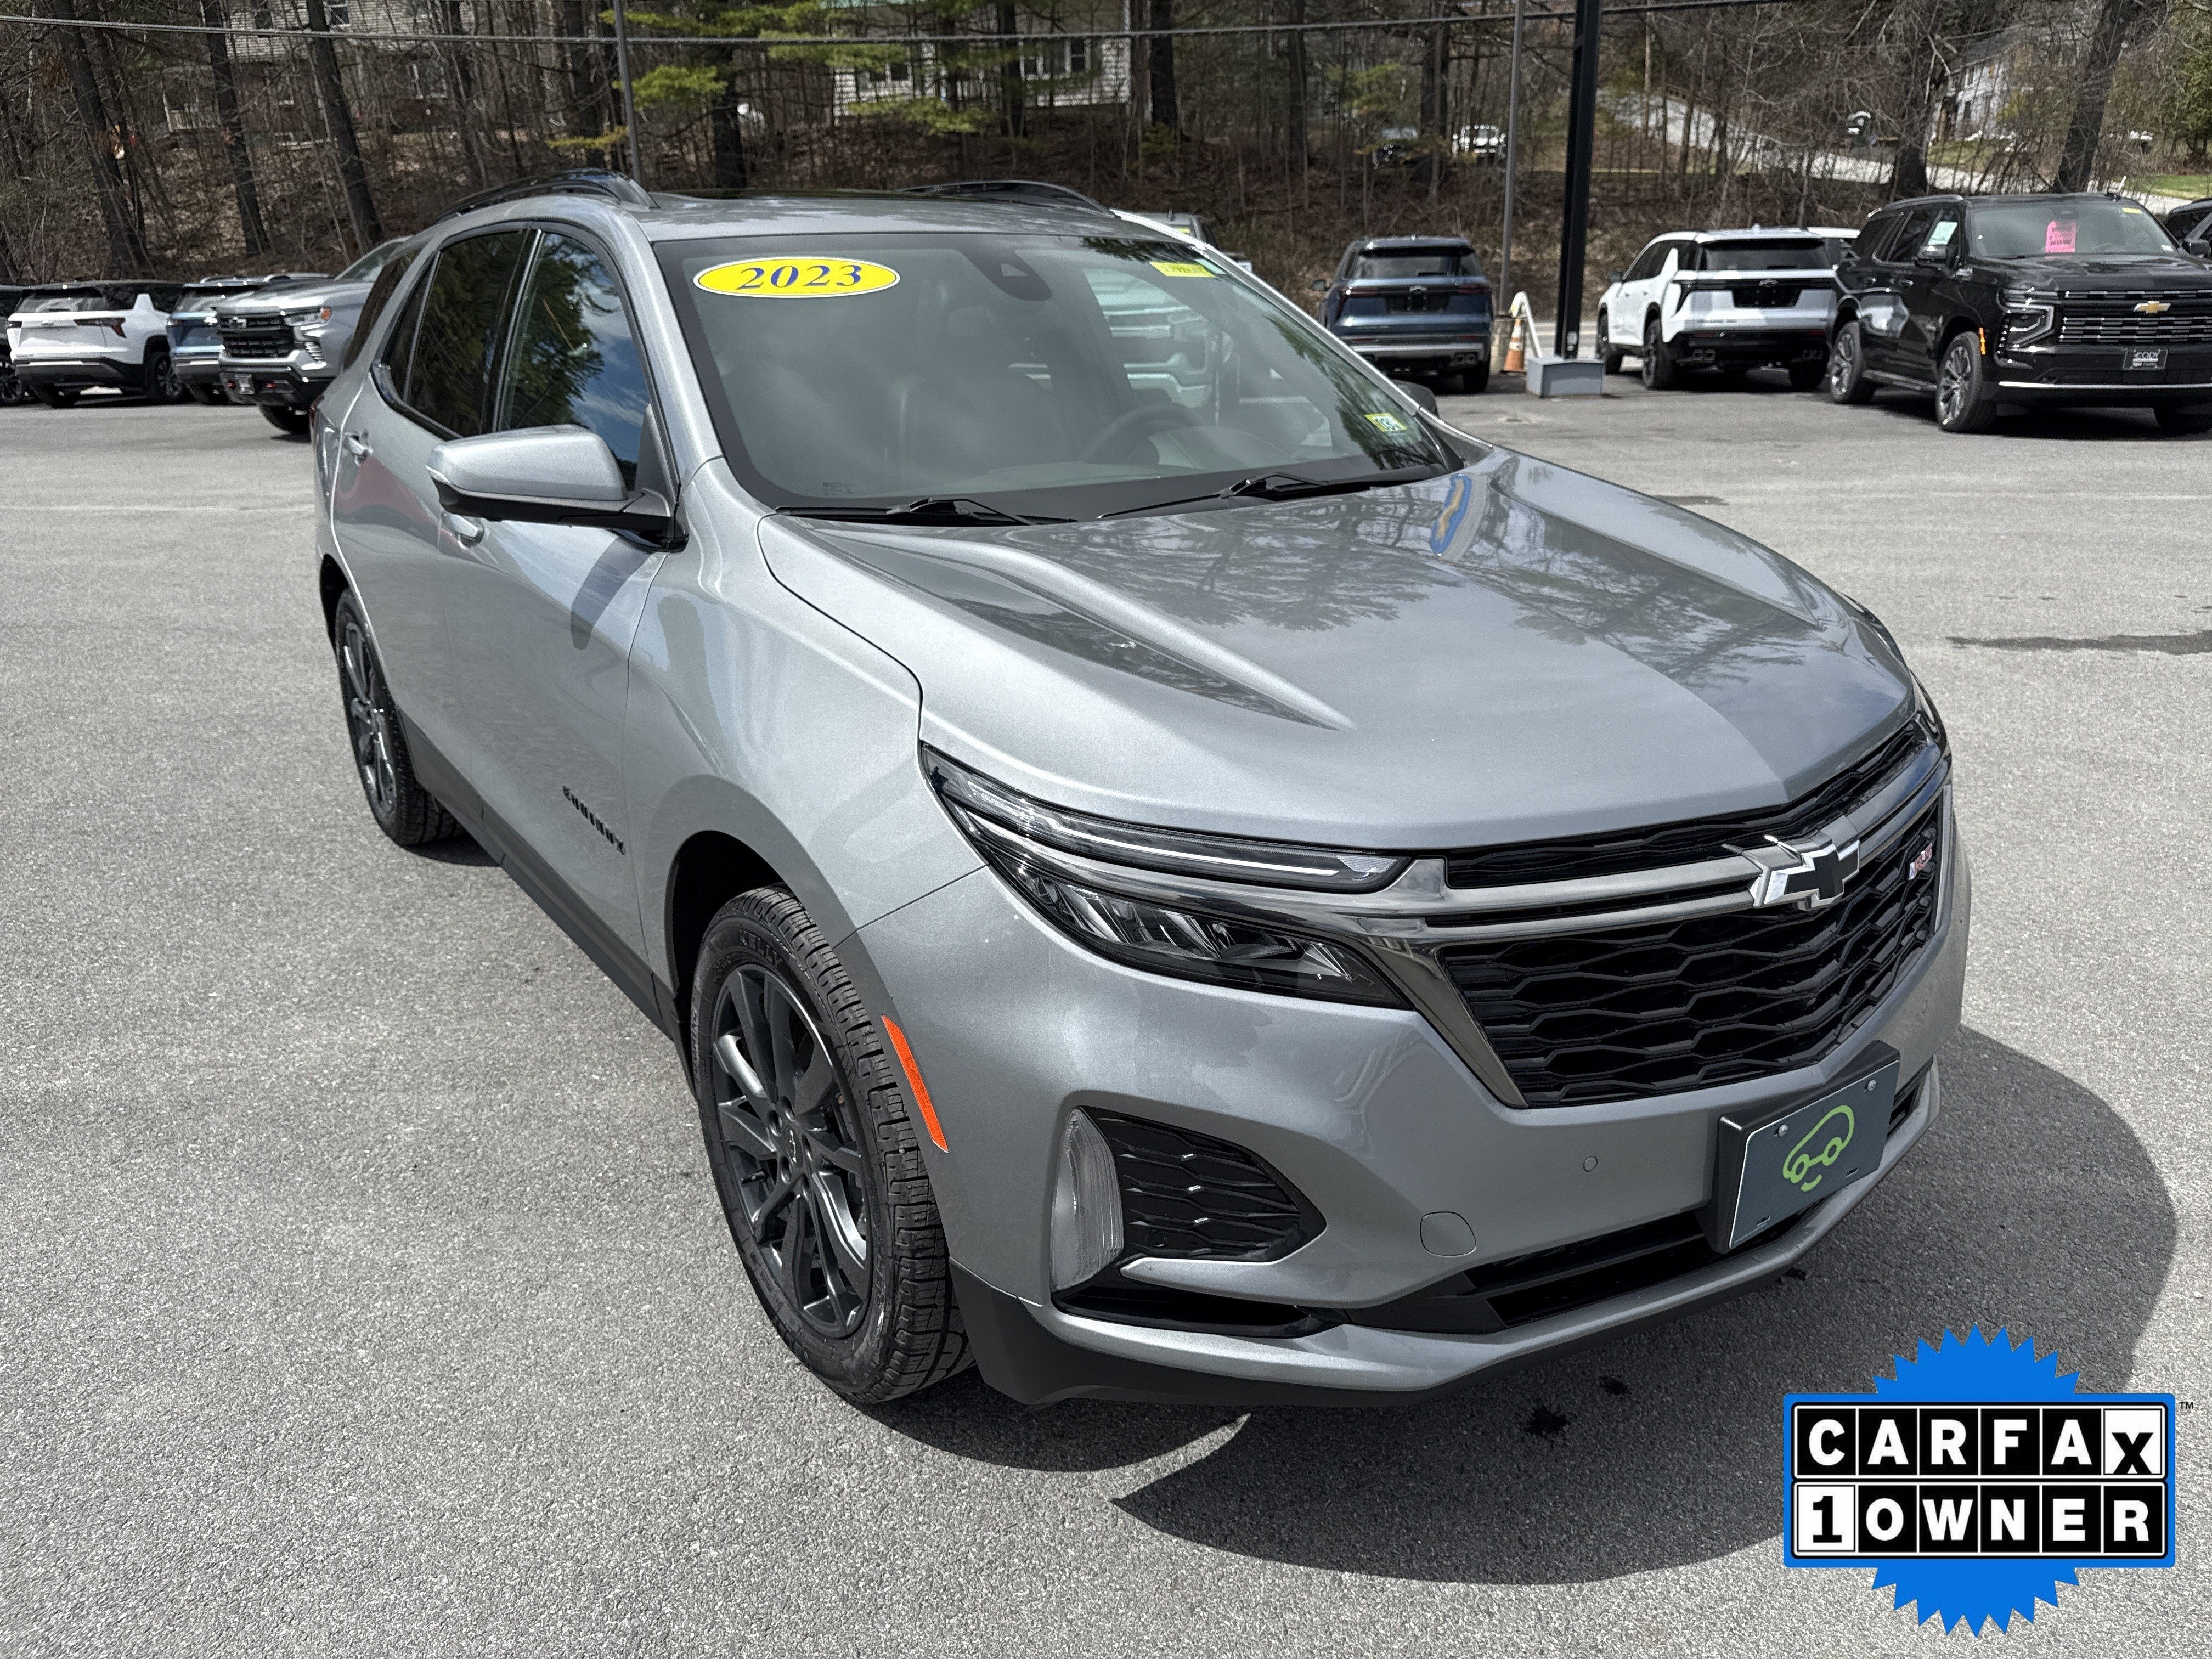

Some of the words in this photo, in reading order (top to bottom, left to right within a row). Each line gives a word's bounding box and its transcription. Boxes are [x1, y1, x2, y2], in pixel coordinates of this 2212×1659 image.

[735, 264, 861, 290] 2023
[981, 792, 1005, 809] EQUINOX
[1909, 842, 1933, 880] RS
[737, 929, 783, 969] KELLY
